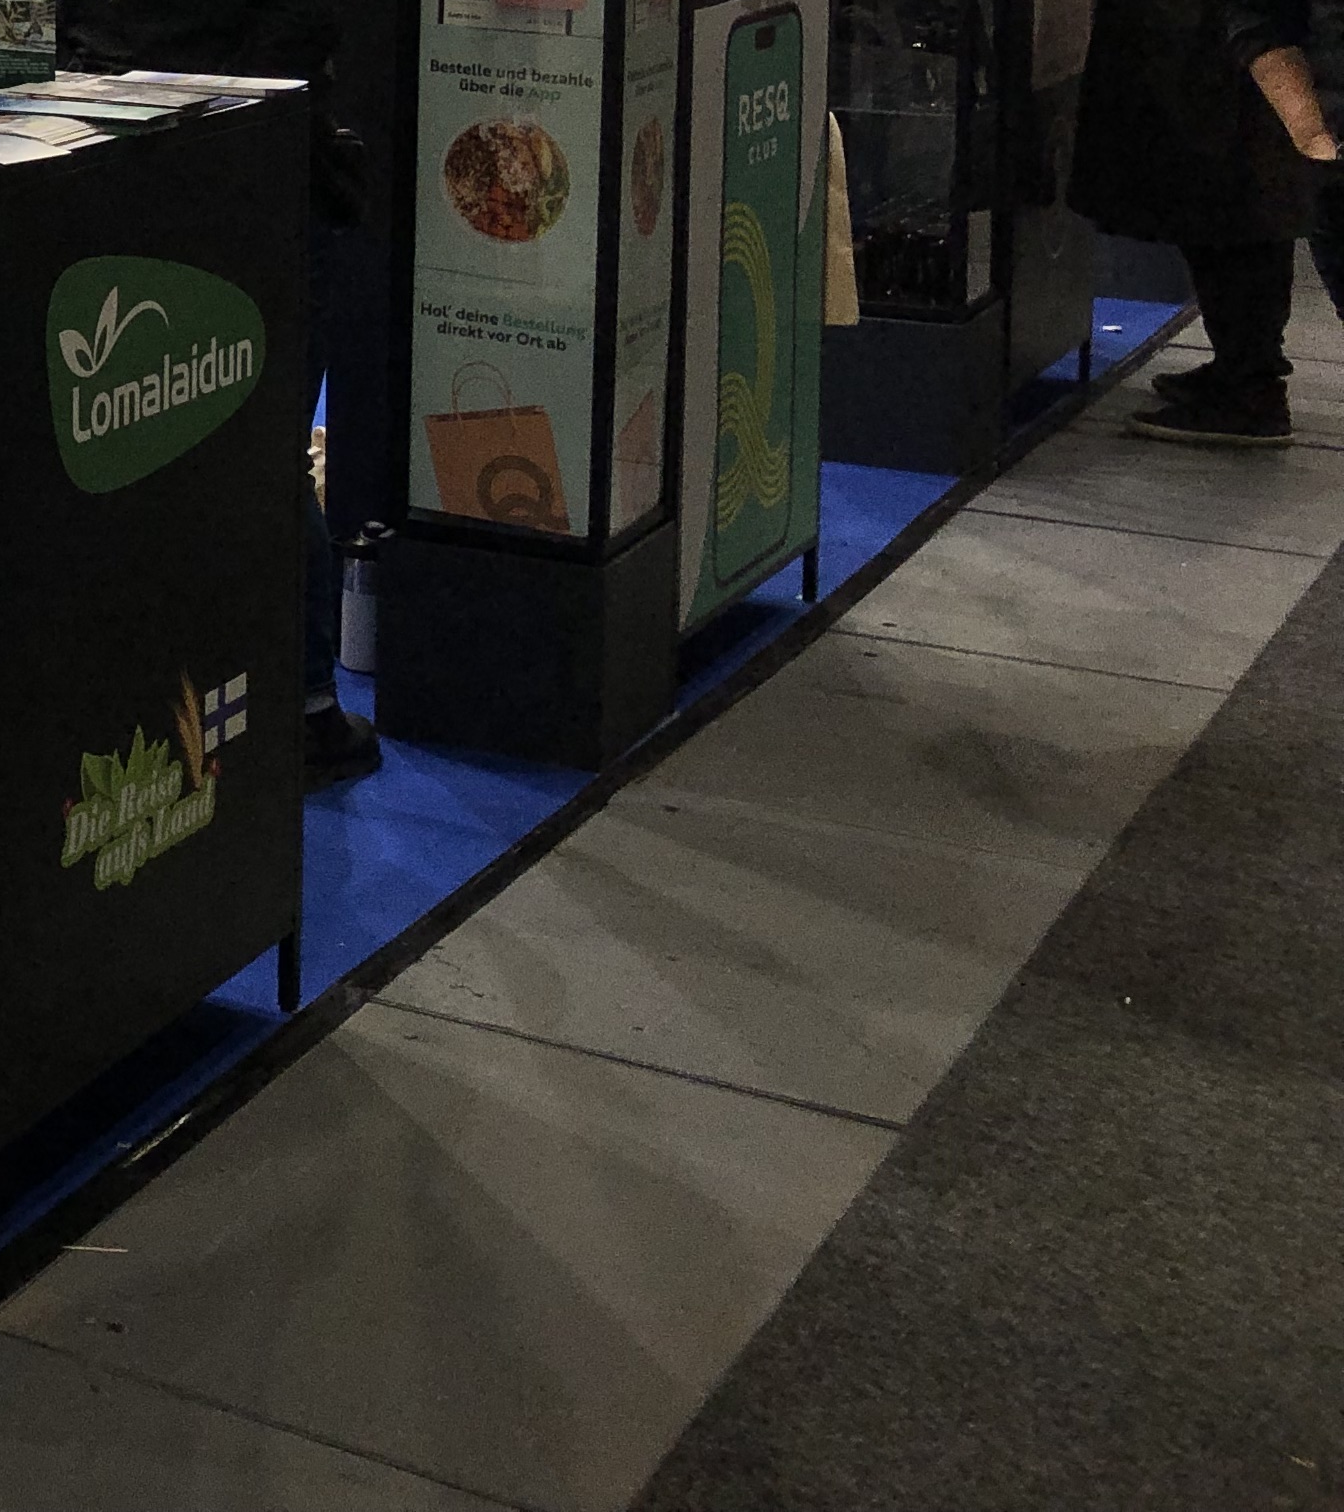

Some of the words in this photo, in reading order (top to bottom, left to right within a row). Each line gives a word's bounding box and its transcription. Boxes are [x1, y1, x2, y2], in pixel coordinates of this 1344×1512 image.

[430, 59, 492, 78] Bestelle
[496, 68, 526, 81] und
[531, 69, 594, 88] bezahle
[459, 78, 496, 94] über
[499, 83, 524, 97] die
[527, 88, 561, 103] App
[738, 81, 790, 136] RESQ
[455, 308, 499, 326] deine
[437, 321, 484, 339] direkt
[487, 330, 512, 343] vor
[516, 332, 543, 349] Ort
[546, 337, 567, 352] ab
[72, 336, 253, 444] Lomalaidun
